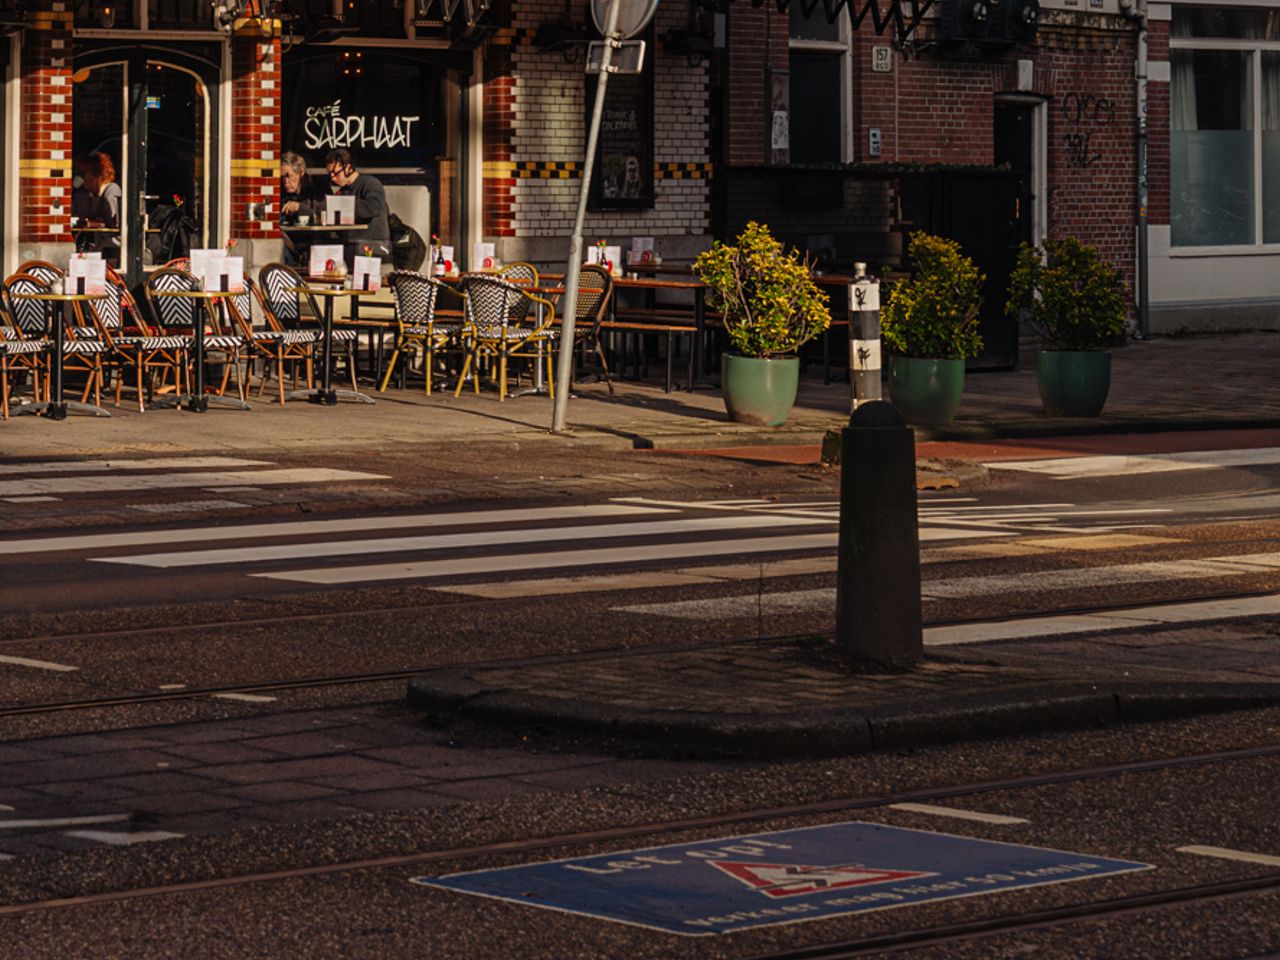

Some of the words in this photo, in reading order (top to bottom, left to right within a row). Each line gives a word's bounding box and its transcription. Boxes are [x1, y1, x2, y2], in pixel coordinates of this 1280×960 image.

[305, 99, 341, 117] CAFÉ
[304, 116, 420, 149] SARPHAAT
[565, 853, 683, 874] Let
[685, 840, 792, 859] op!
